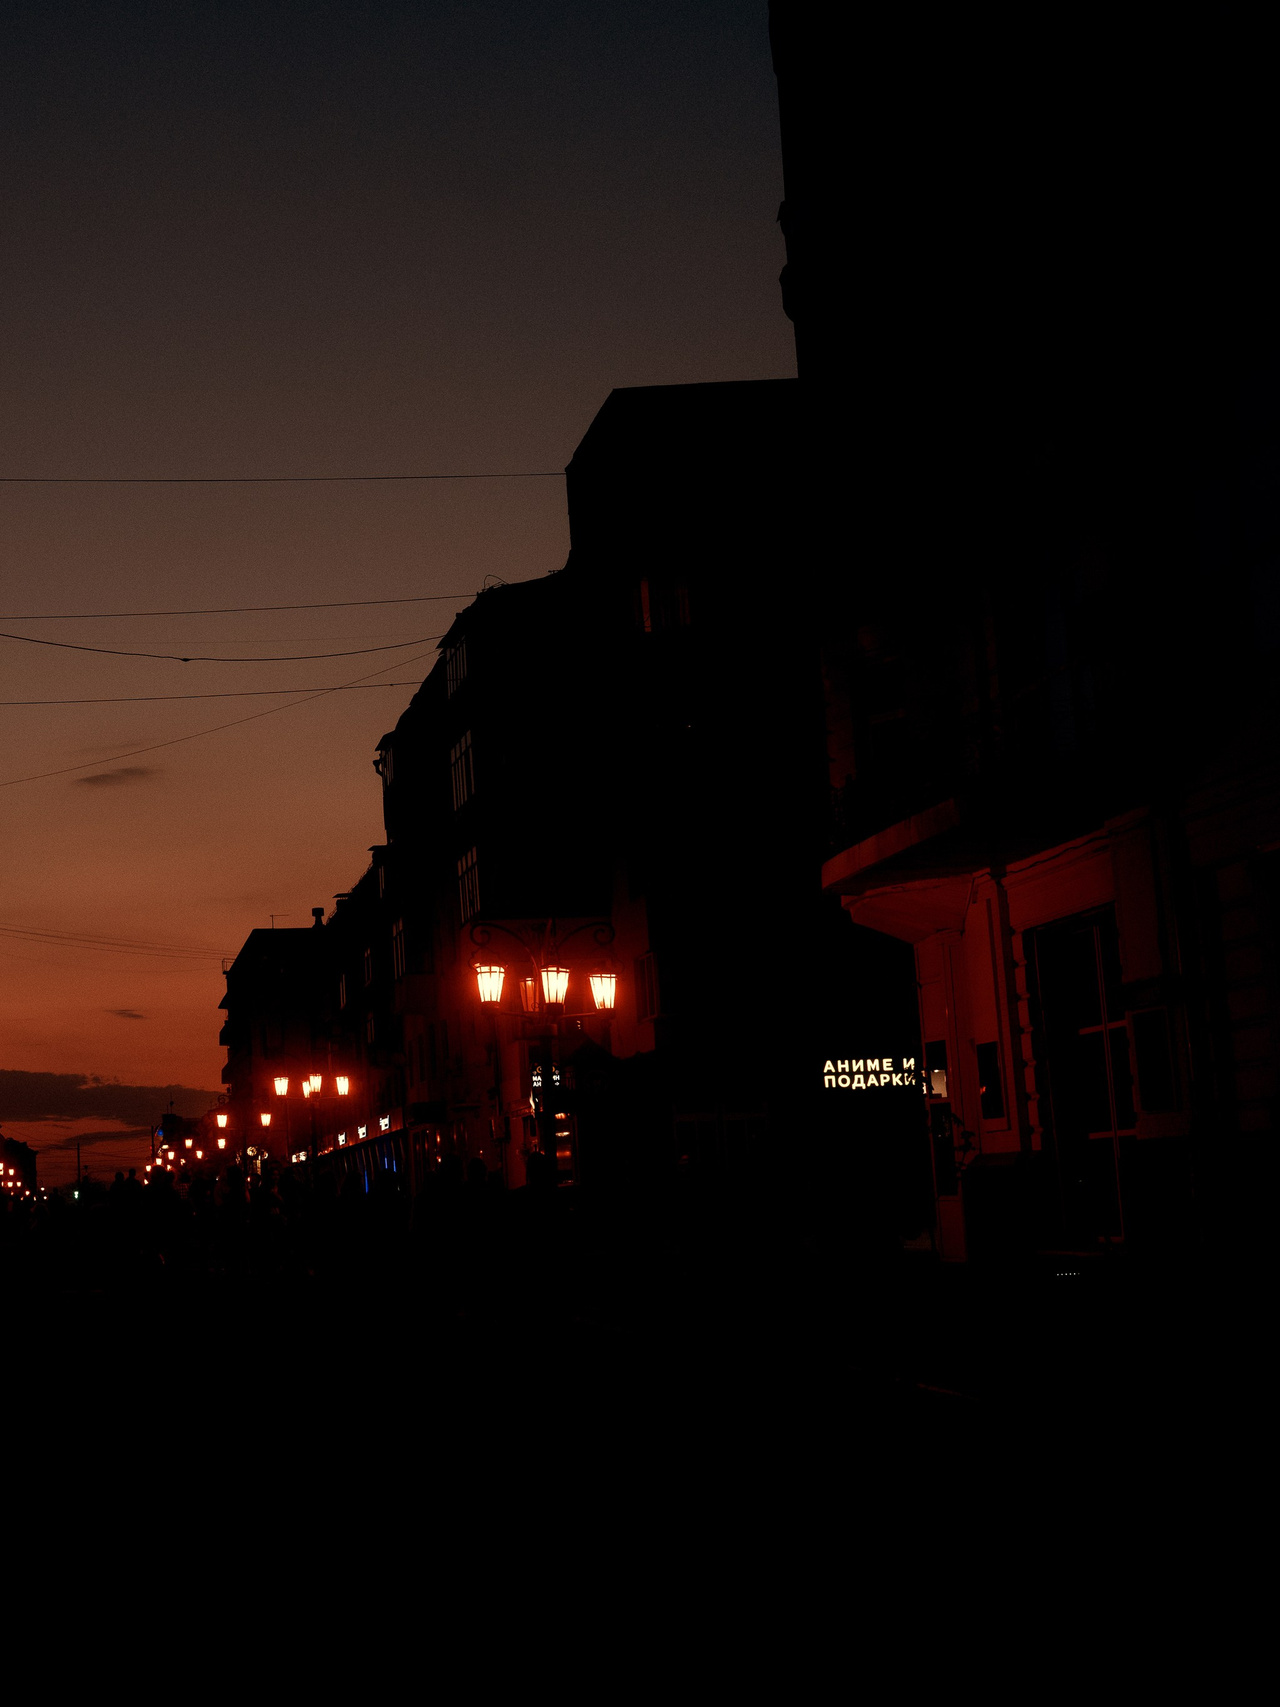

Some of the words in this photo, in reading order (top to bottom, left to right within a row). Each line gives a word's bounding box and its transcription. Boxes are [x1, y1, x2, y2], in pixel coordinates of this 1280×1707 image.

[823, 1058, 894, 1073] АНИМЕ
[902, 1057, 915, 1071] И
[823, 1073, 916, 1090] ПОДАРКИ
